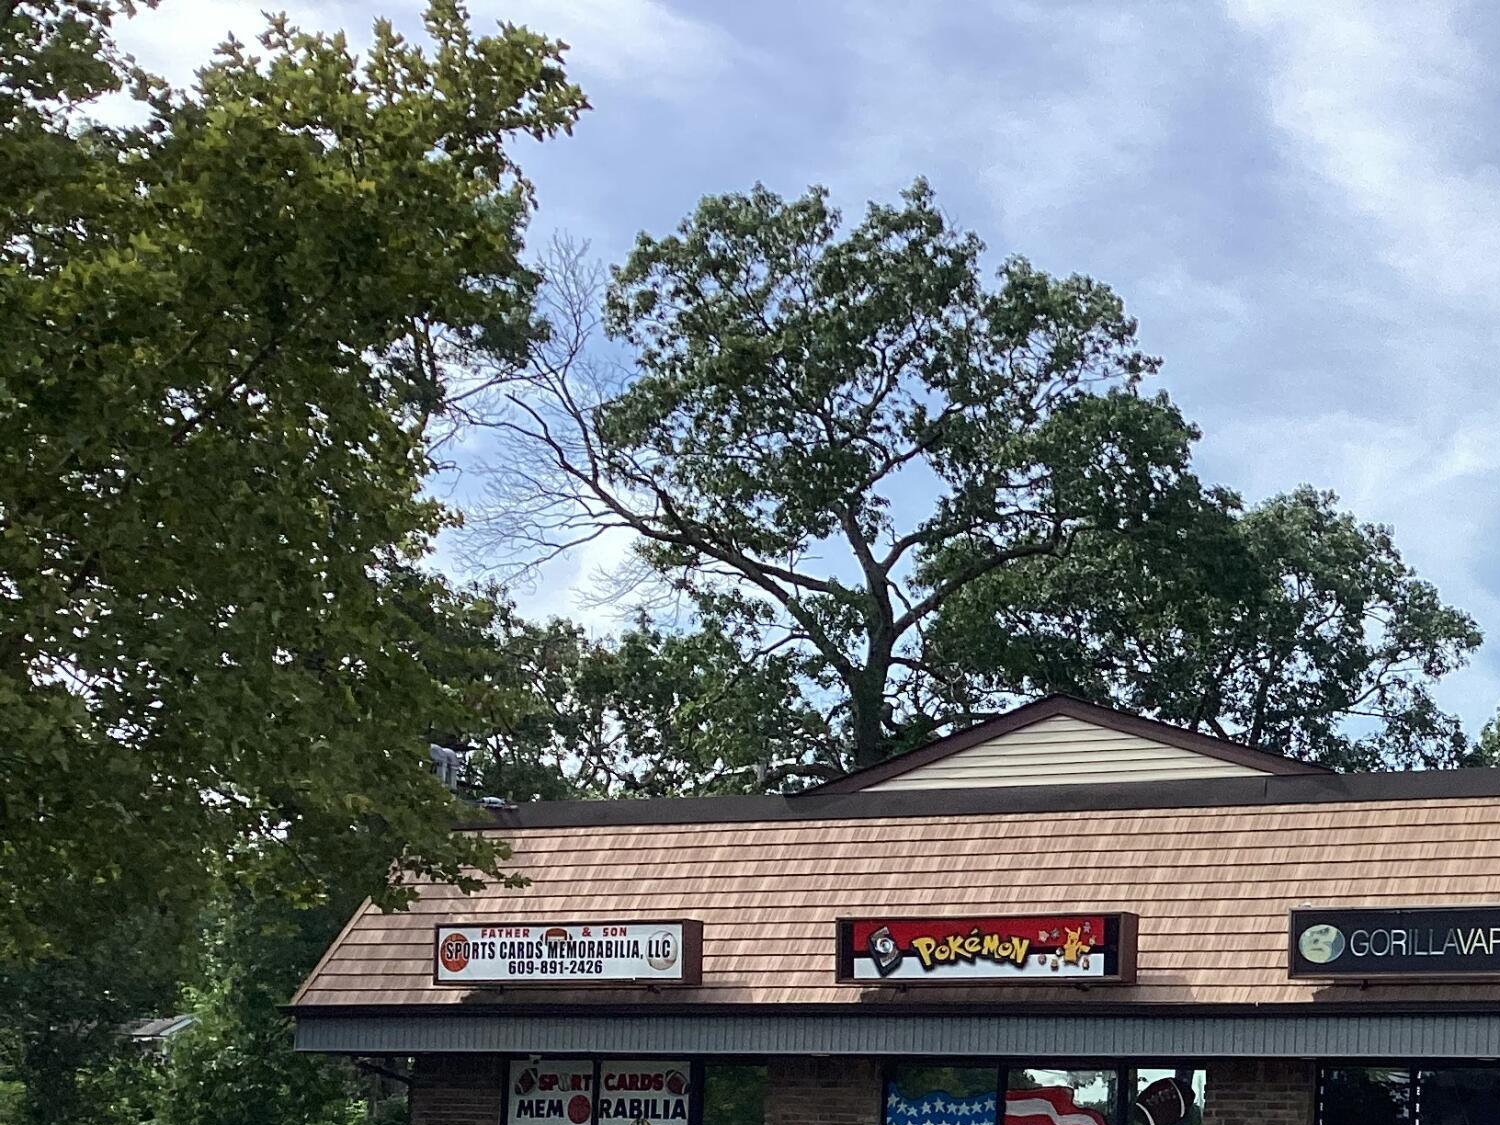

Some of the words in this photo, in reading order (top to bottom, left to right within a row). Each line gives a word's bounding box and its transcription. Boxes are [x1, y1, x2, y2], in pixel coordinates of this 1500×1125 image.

[481, 928, 530, 939] FATHER
[581, 927, 592, 938] &
[602, 926, 628, 937] SON
[446, 941, 495, 961] SPORTS
[499, 940, 543, 960] CARDS
[547, 939, 644, 961] MEMORABILIA,
[648, 939, 671, 958] LLC
[508, 959, 603, 975] 609-891-2426
[604, 1073, 664, 1092] CARDS
